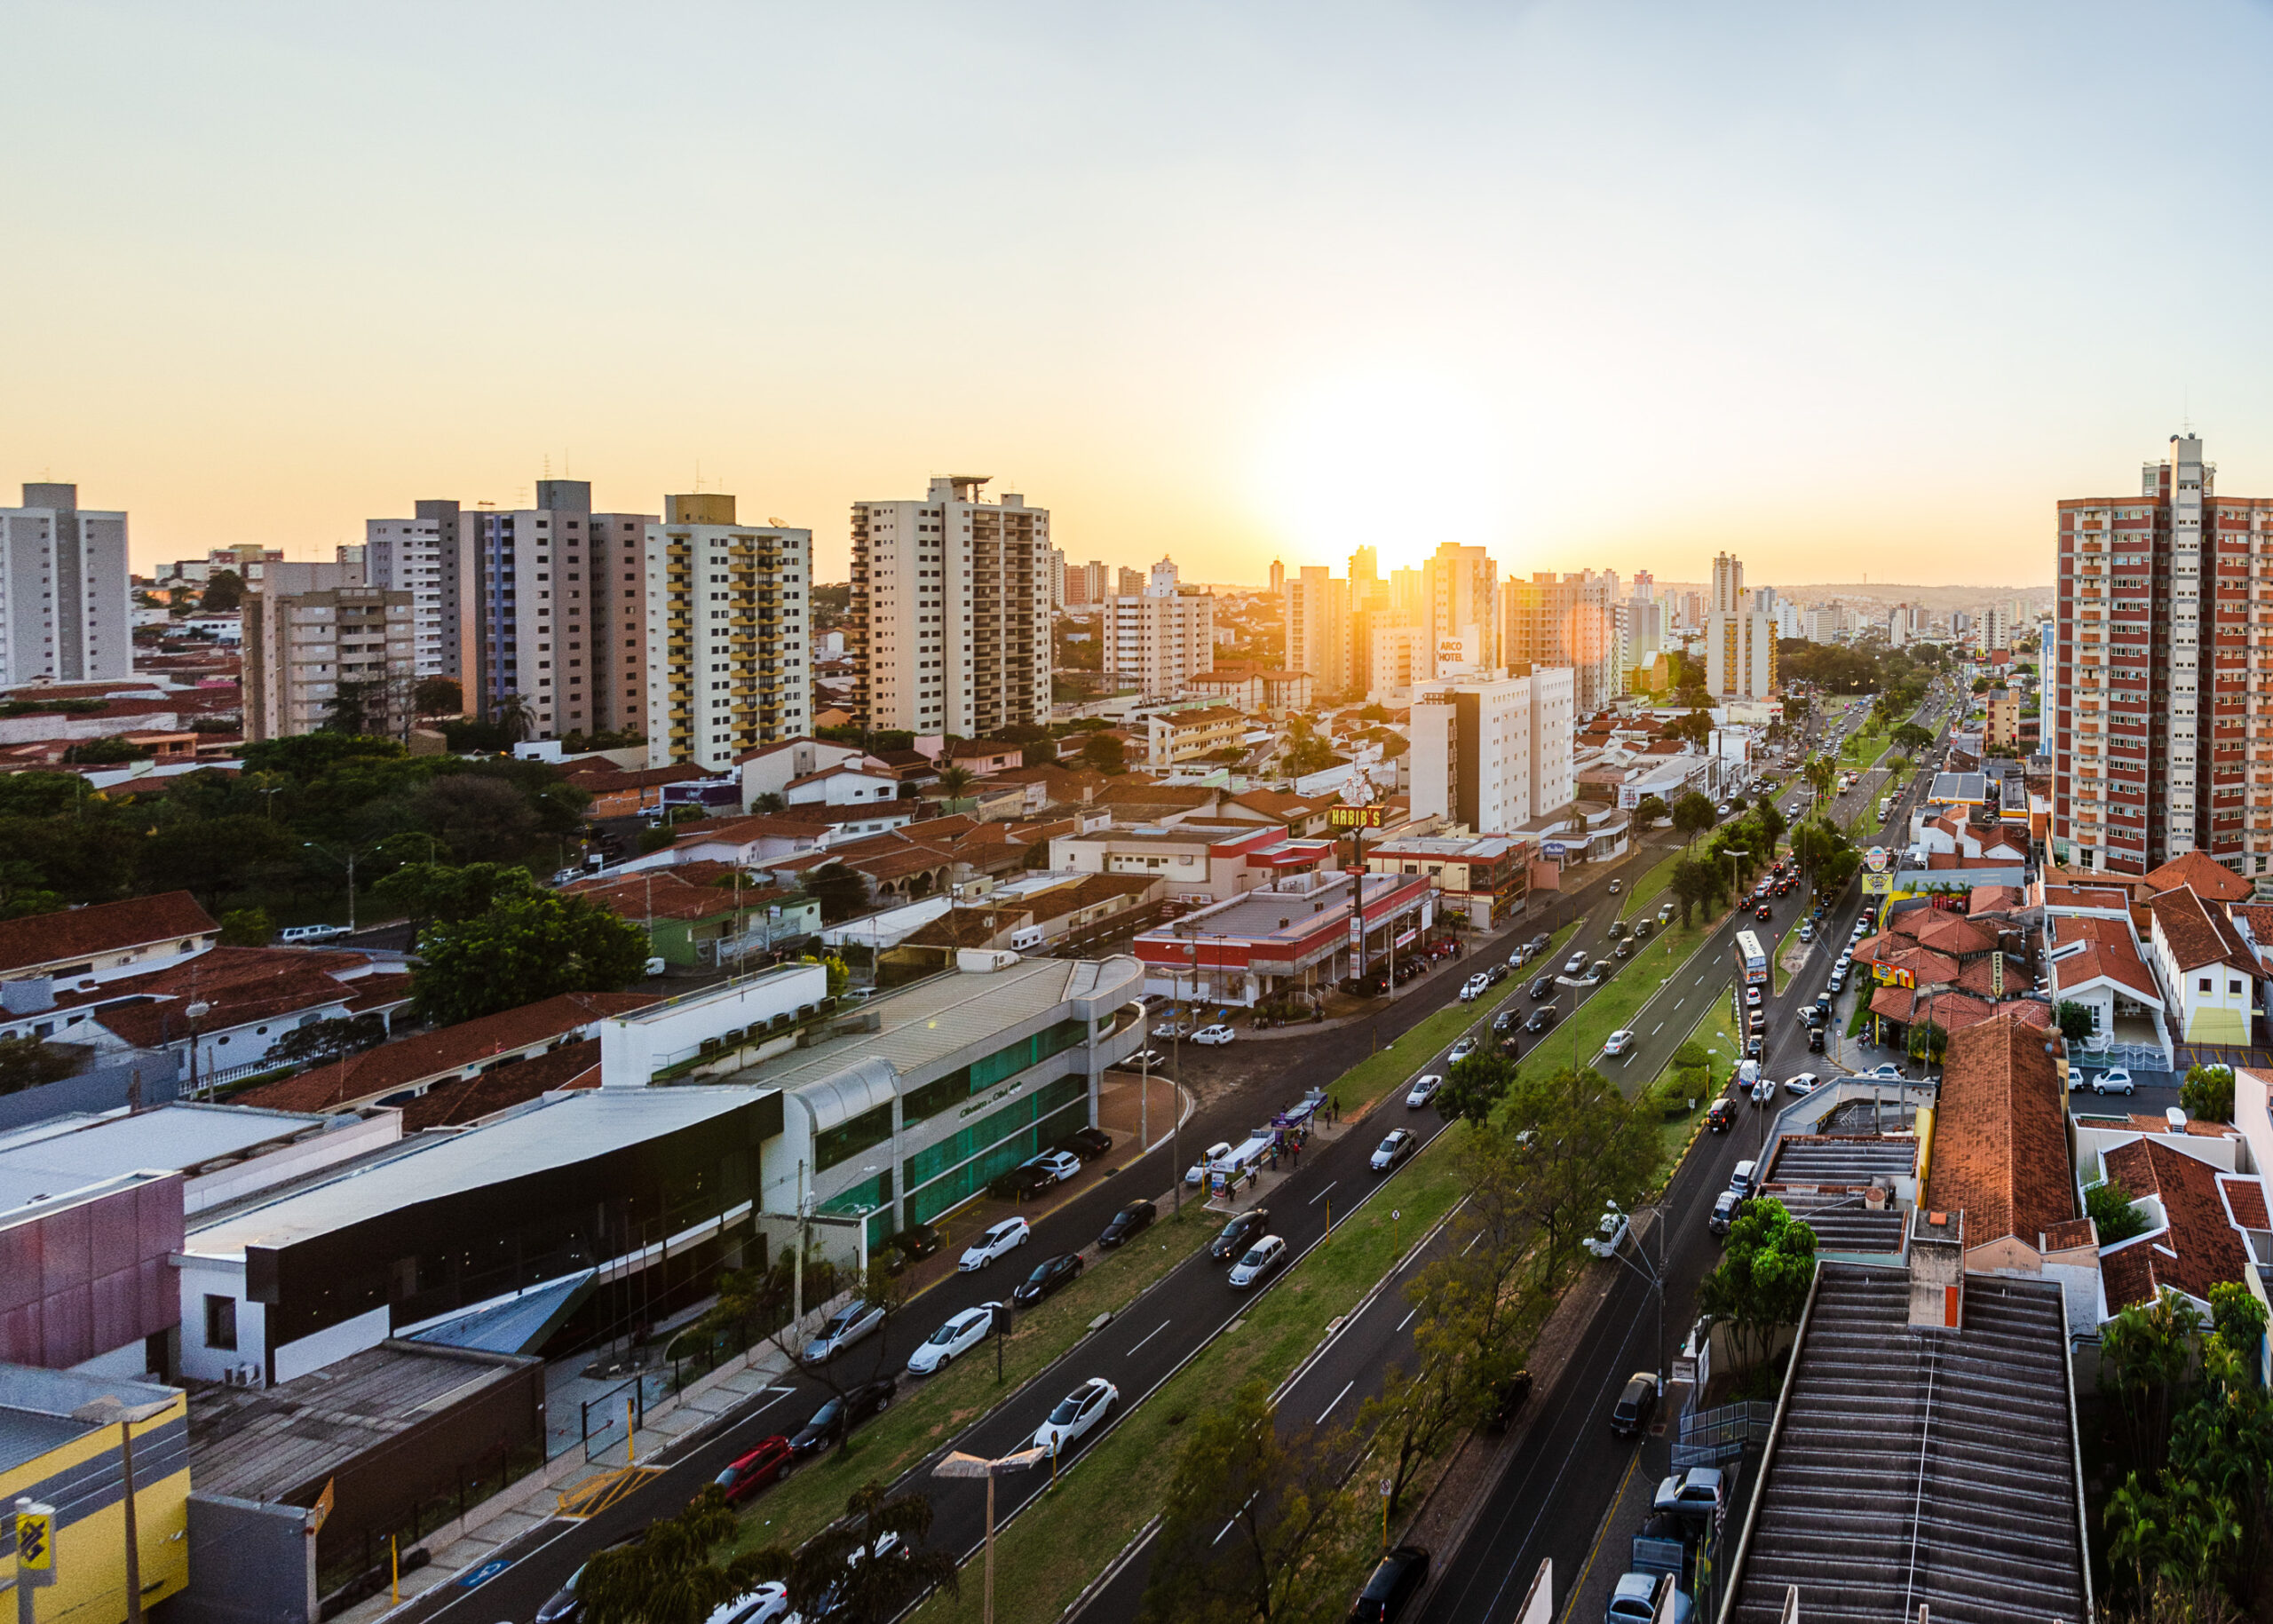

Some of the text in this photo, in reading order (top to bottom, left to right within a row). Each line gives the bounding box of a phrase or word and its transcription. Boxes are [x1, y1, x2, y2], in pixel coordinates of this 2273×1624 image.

[1440, 641, 1462, 651] ARCO
[1438, 653, 1463, 661] HOTEL
[1332, 809, 1381, 827] HABIB'S
